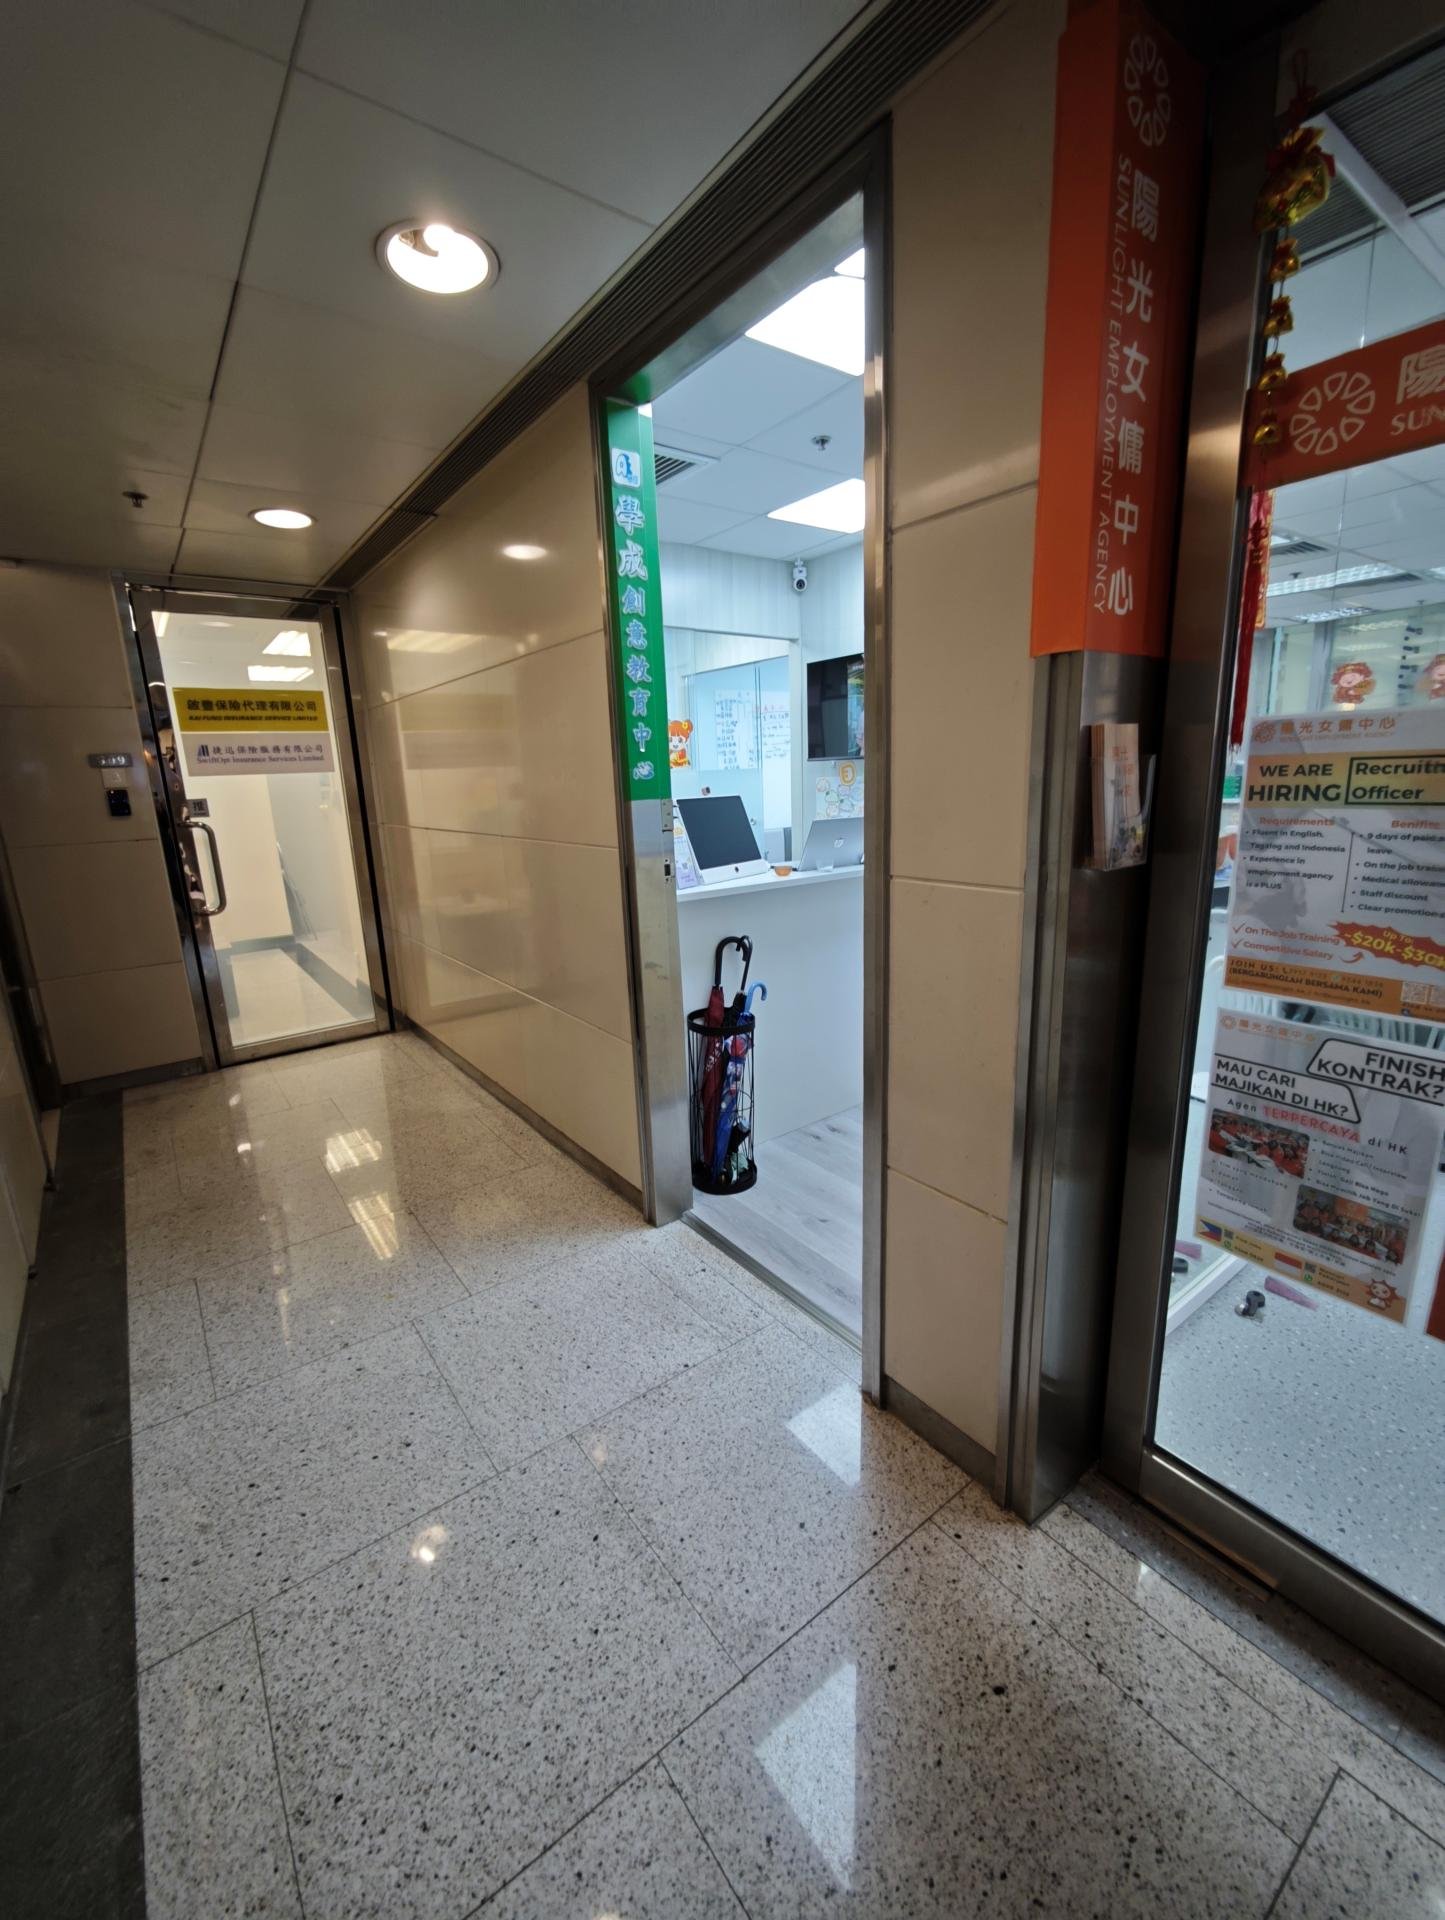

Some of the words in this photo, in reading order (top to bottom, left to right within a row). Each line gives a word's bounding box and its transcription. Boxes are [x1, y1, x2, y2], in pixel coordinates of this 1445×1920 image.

[1110, 154, 1133, 316] SUNLIGHT
[1107, 168, 1160, 616] 陽光女傭中心
[1101, 319, 1122, 505] EMPLOYMENT
[1094, 511, 1111, 614] AGENCY
[614, 495, 655, 780] 學成創意教育中心
[1260, 765, 1289, 778] WE
[1293, 763, 1333, 777] ARE
[1355, 760, 1445, 776] Recruit
[1249, 784, 1341, 802] HIRING
[1351, 784, 1424, 800] Officer
[1375, 833, 1398, 841] days
[1284, 843, 1300, 851] and
[1302, 845, 1345, 853] Indonesia
[1249, 856, 1295, 865] Experience
[1397, 863, 1414, 871] job
[1248, 869, 1300, 878] employment
[1302, 872, 1334, 881] agency
[1361, 876, 1399, 884] Medical
[1360, 890, 1382, 898] Staff
[1384, 891, 1428, 902] discount
[1358, 904, 1382, 912] Clear
[1245, 926, 1258, 934] On
[1261, 928, 1278, 936] The
[1279, 930, 1297, 939] Job
[1299, 932, 1341, 946] Training
[1243, 941, 1301, 955] Competitive
[1302, 948, 1334, 960] Salary
[1217, 1059, 1252, 1077] MAU
[1257, 1070, 1296, 1088] CARI
[1365, 1052, 1445, 1082] FINISH
[1317, 1058, 1444, 1099] KONTRAK?
[1215, 1073, 1286, 1101] MAJIKAN
[1291, 1093, 1308, 1106] DI
[1314, 1099, 1348, 1117] HK?
[1227, 1098, 1257, 1112] Agen
[1263, 1106, 1360, 1143] TERPERCAYA
